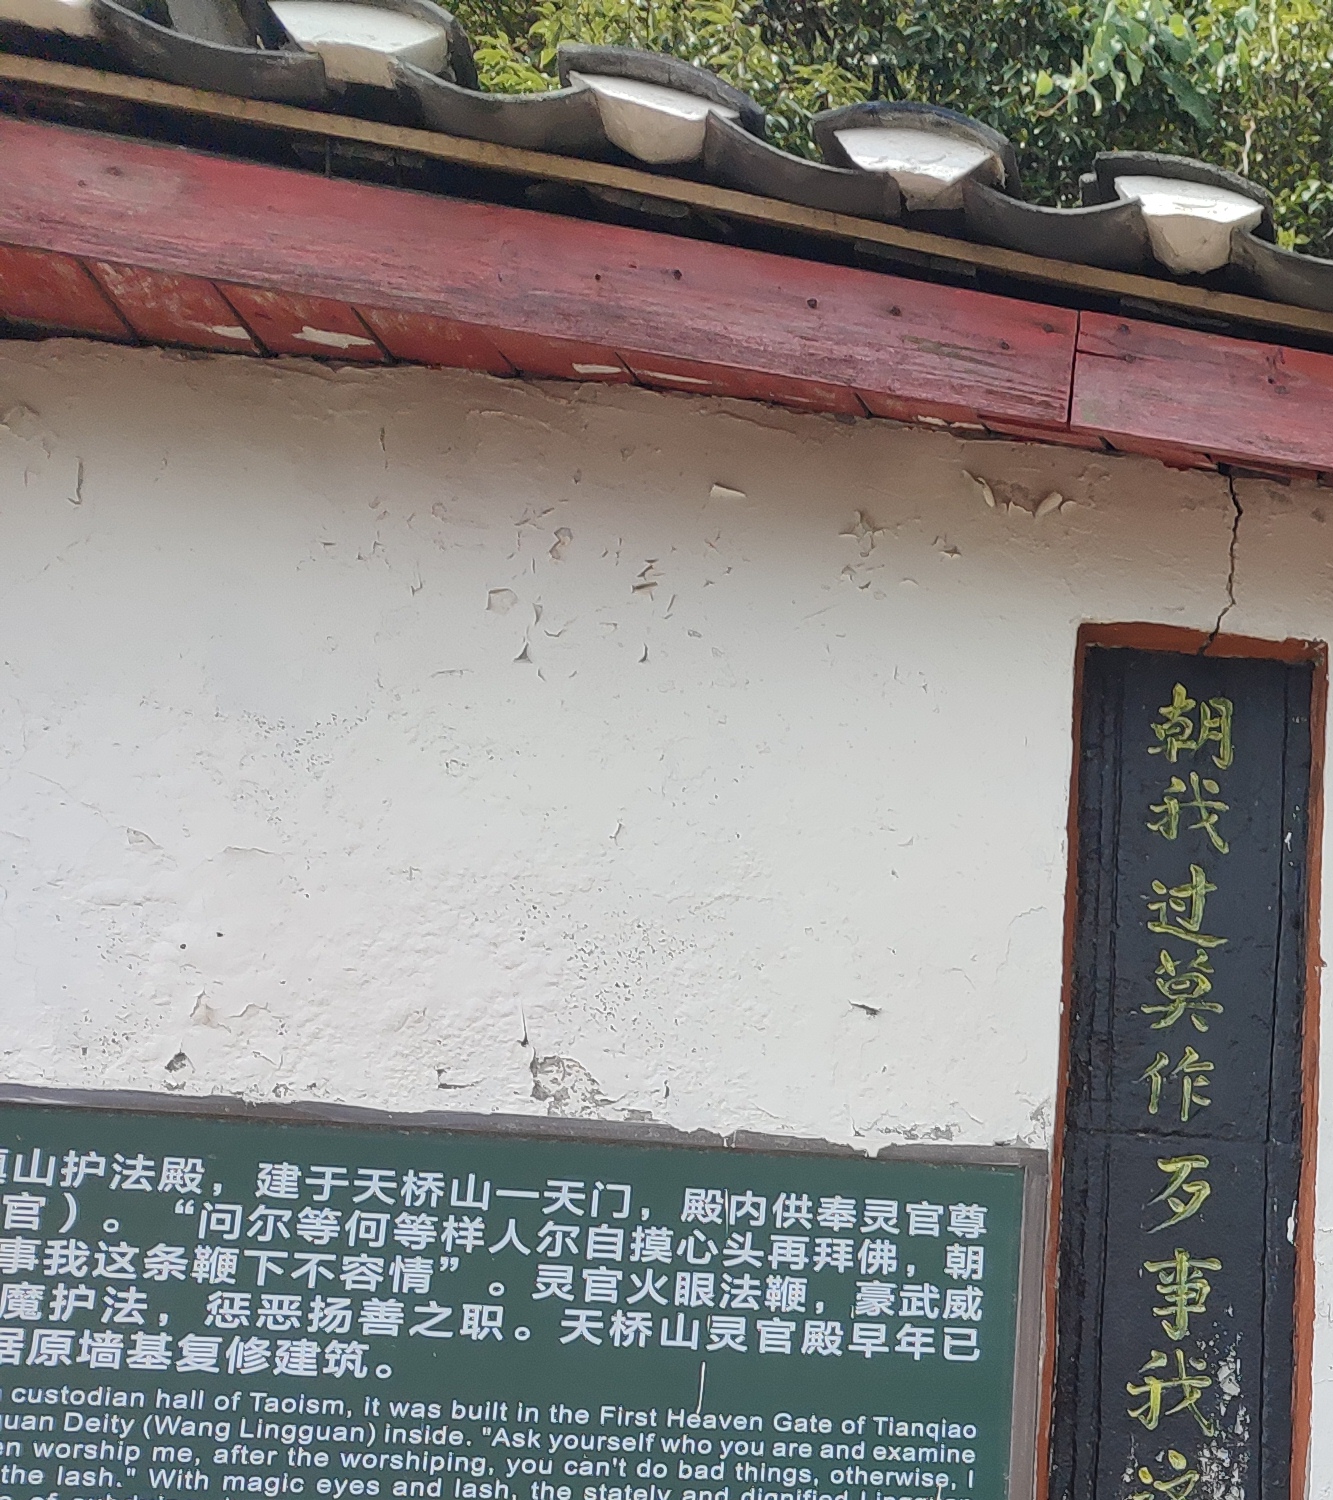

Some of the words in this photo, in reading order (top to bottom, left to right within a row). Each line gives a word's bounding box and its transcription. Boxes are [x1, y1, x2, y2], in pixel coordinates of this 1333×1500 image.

[0, 1148, 988, 1239] 山护法殿，建于天桥山一天门，殿内供奉灵官尊
[12, 1386, 144, 1407] custodian
[156, 1389, 204, 1409] hall
[215, 1392, 242, 1411] of
[250, 1392, 351, 1418] Taoism,
[365, 1397, 380, 1416] it
[389, 1402, 441, 1419] was
[452, 1400, 508, 1421] built
[518, 1402, 538, 1423] in
[550, 1404, 589, 1424] the
[601, 1406, 657, 1426] First
[667, 1407, 763, 1431] Heaven
[773, 1413, 832, 1433] Gate
[841, 1416, 866, 1436] of
[873, 1416, 976, 1442] Tianqiao
[64, 1412, 135, 1438] Deity
[144, 1415, 230, 1442] (Wang
[240, 1417, 375, 1447] Lingguan)
[385, 1424, 471, 1446] inside.
[483, 1427, 540, 1448] "Ask
[549, 1433, 656, 1453] yourself
[661, 1434, 712, 1454] who
[720, 1440, 764, 1459] you
[773, 1443, 812, 1457] are
[820, 1441, 864, 1459] and
[873, 1444, 975, 1463] examine
[1, 1464, 43, 1484] the
[57, 1466, 136, 1487] lash."
[149, 1469, 208, 1490] With
[223, 1473, 304, 1497] magic
[317, 1478, 379, 1499] eyes
[393, 1478, 441, 1497] and
[531, 1481, 571, 1500] the
[33, 1440, 140, 1465] worship
[153, 1447, 200, 1466] me,
[213, 1445, 278, 1466] after
[288, 1447, 328, 1467] the
[340, 1451, 494, 1476] worshiping,
[506, 1458, 552, 1477] you
[565, 1454, 626, 1477] can't
[637, 1459, 667, 1478] do
[679, 1460, 724, 1480] bad
[735, 1462, 818, 1487] things,
[831, 1466, 956, 1490] otherwise,
